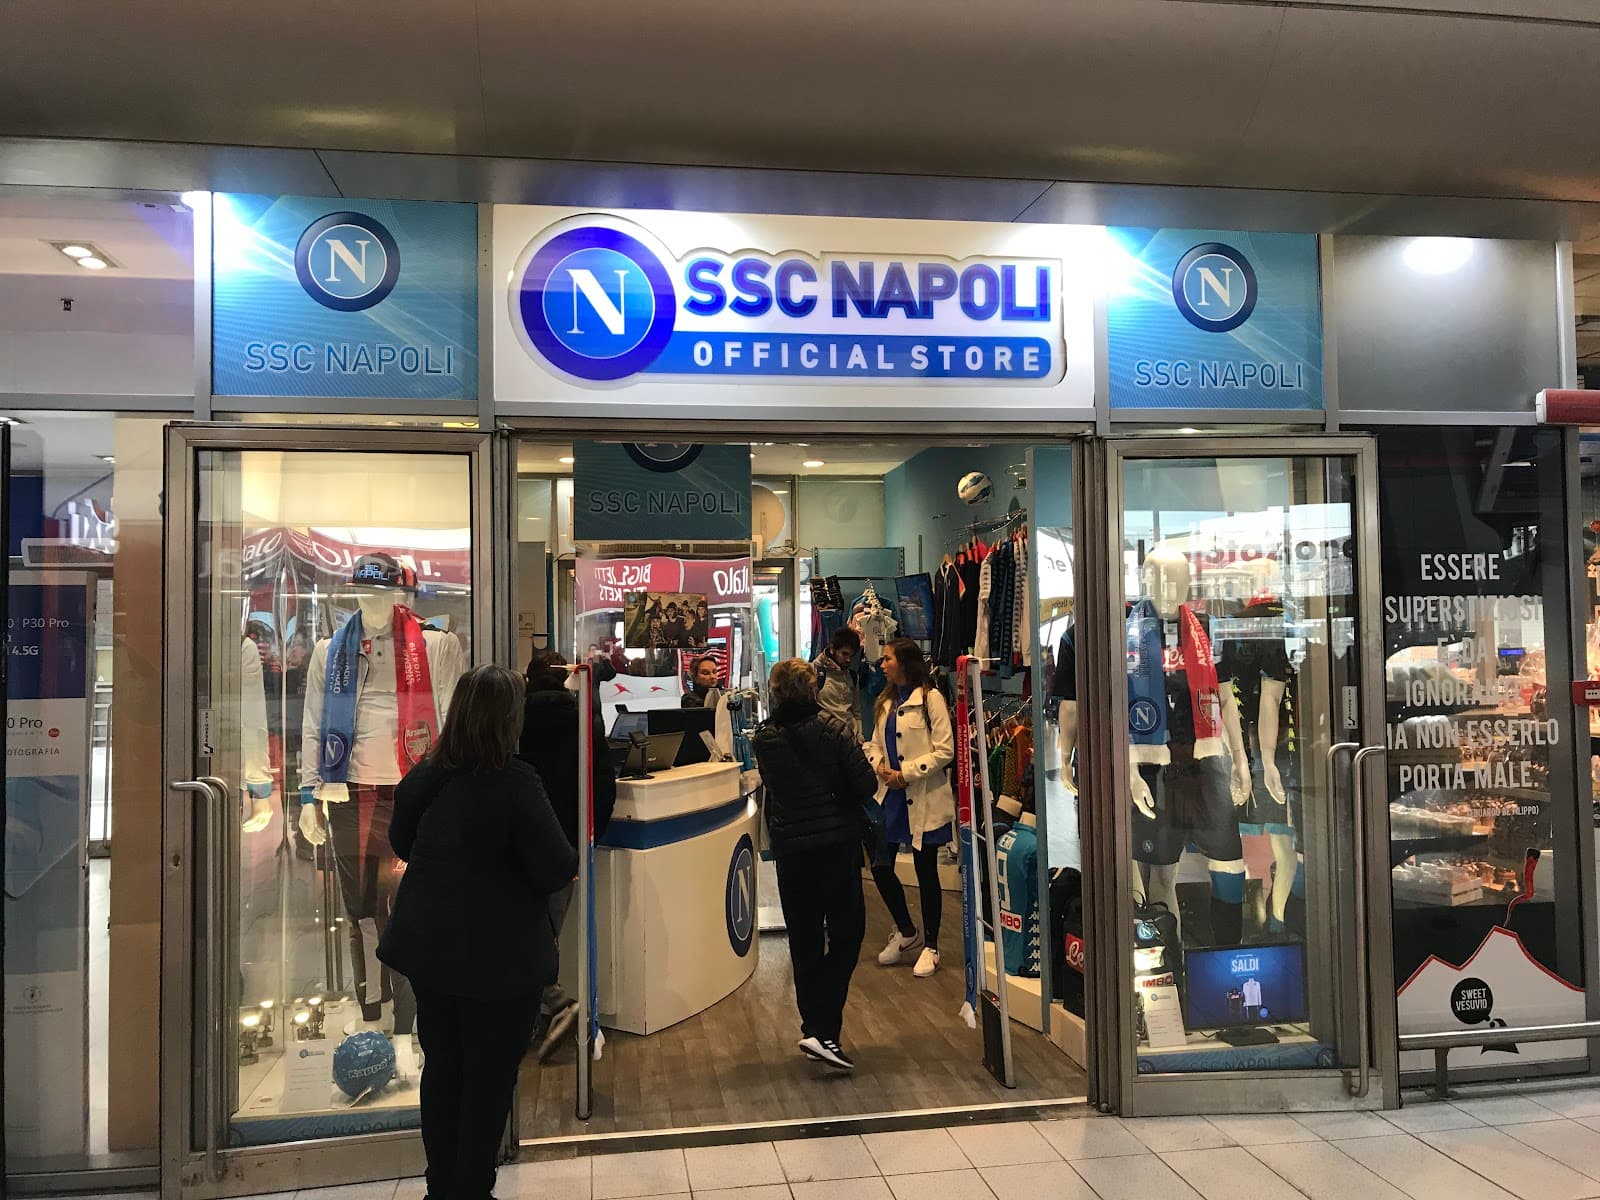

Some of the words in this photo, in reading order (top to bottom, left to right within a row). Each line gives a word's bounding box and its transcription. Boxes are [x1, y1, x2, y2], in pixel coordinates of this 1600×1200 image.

[565, 268, 627, 336] N
[682, 257, 818, 318] SSC
[832, 259, 1051, 323] NAPOLI
[244, 340, 314, 374] SSC
[324, 343, 455, 377] NAPOLI
[693, 339, 895, 371] OFFICIAL
[910, 343, 1042, 373] STORE
[1135, 359, 1191, 388] SSC
[1200, 360, 1304, 390] NAPOLI
[589, 490, 640, 514] SSC
[648, 491, 742, 515] NAPOLI
[1421, 553, 1500, 581] ESSERE
[22, 618, 46, 629] P30
[48, 618, 70, 629] Pro
[11, 645, 39, 656] 4.5G
[1462, 636, 1490, 664] DA
[20, 717, 43, 729] Pro
[1416, 720, 1461, 749] NON
[1466, 717, 1560, 748] ESSERLO
[1400, 762, 1467, 793] PORTA
[1474, 760, 1539, 790] MALE.
[1231, 957, 1260, 973] SALDI
[1455, 998, 1488, 1011] VESUVIO
[1461, 988, 1487, 1001] SWEET
